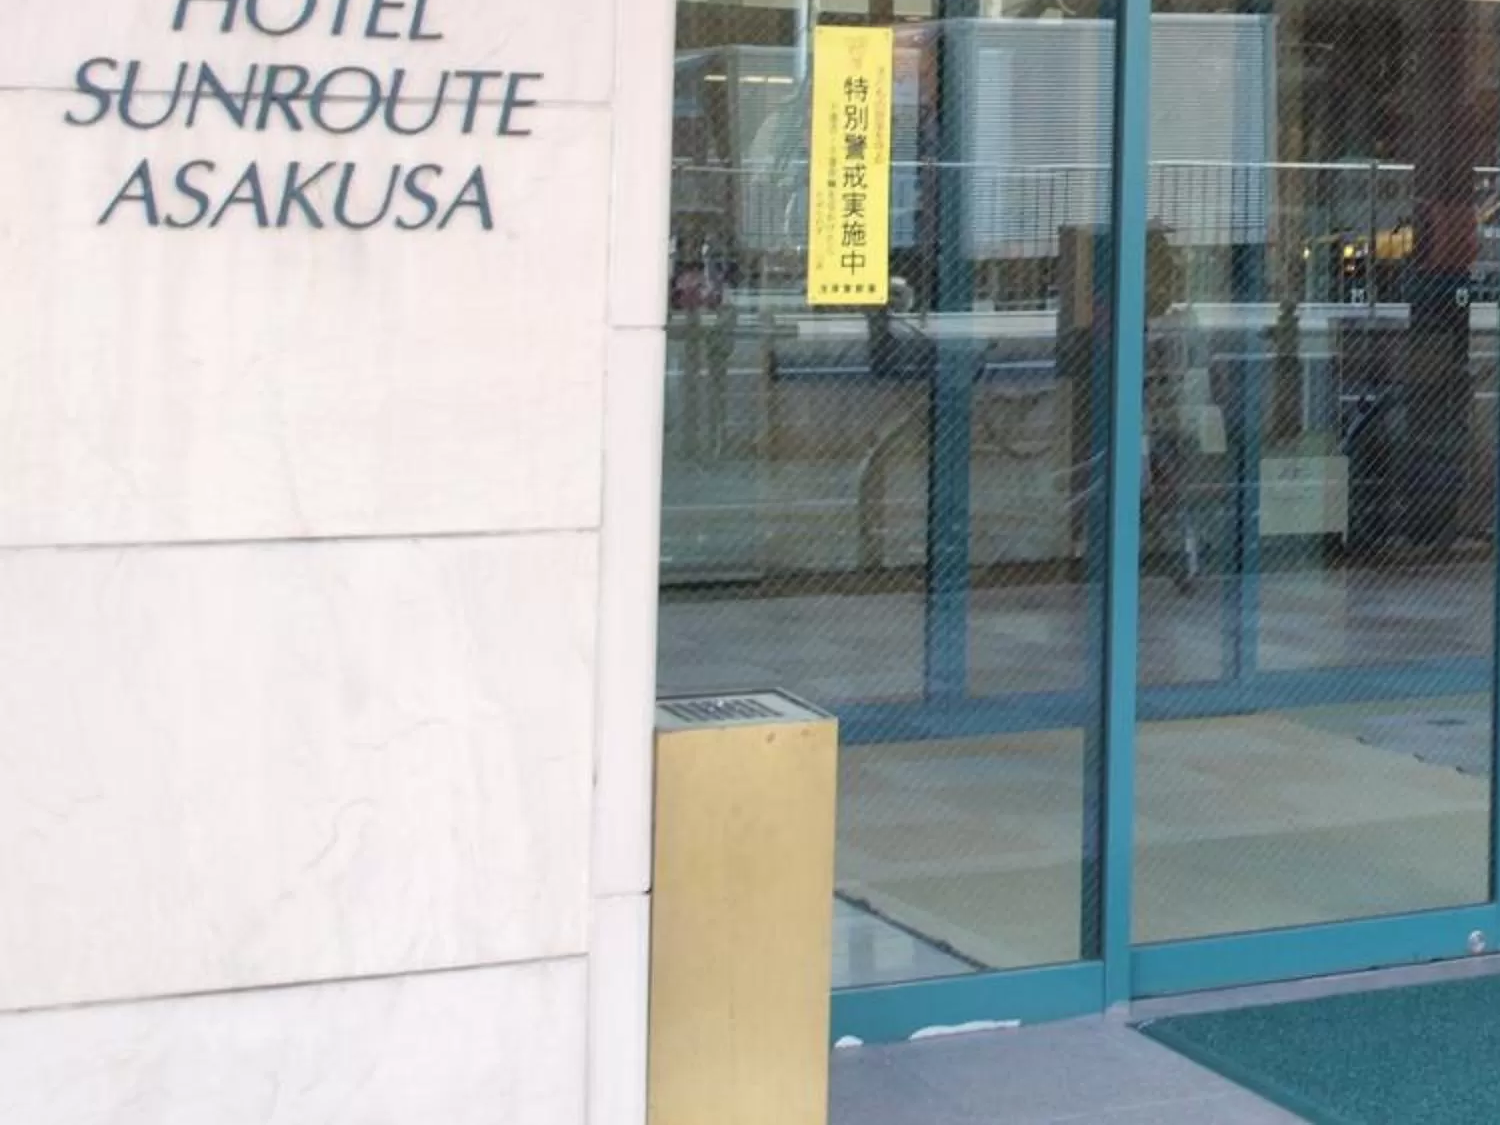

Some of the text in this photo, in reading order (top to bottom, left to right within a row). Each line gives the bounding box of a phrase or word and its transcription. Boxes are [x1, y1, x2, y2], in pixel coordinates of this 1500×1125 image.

[63, 56, 544, 137] SUNROUTE
[98, 157, 495, 231] ASAKUSA
[840, 76, 868, 276] 特別警戒実施中
